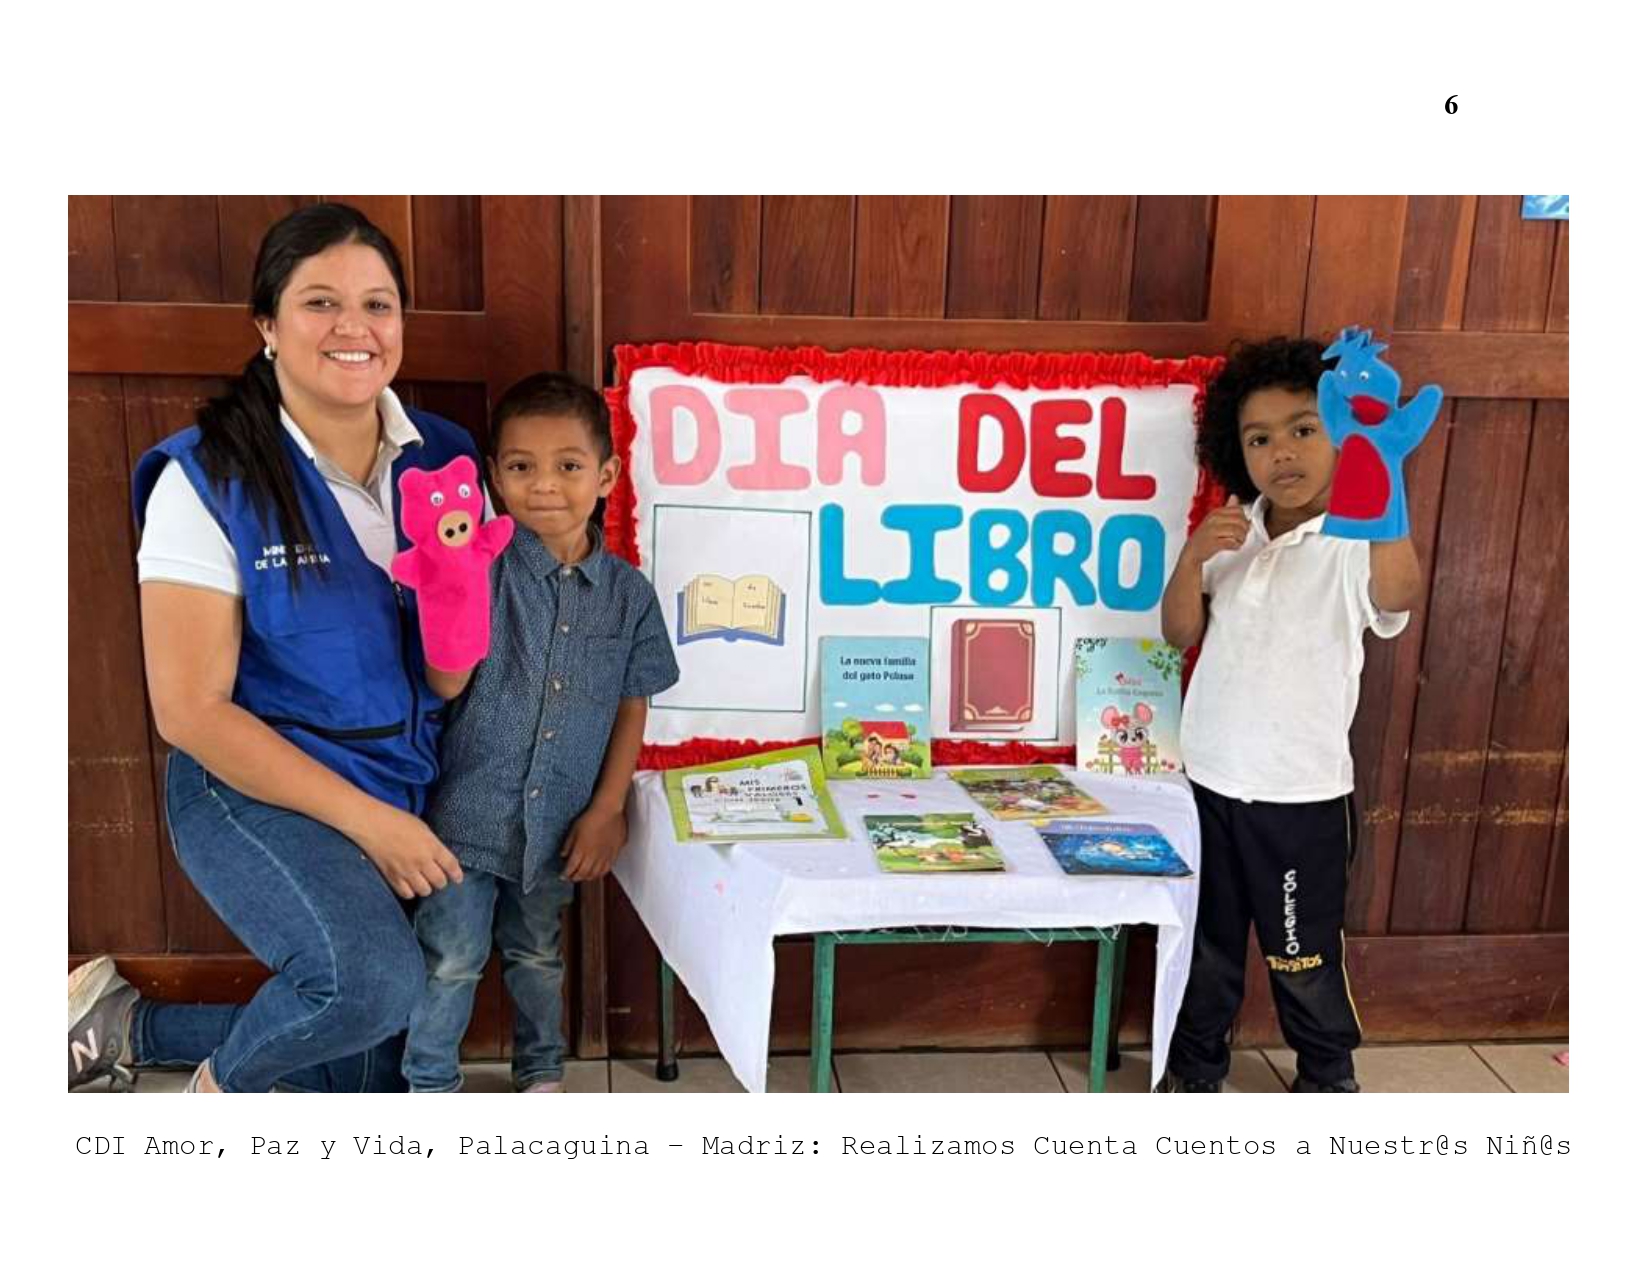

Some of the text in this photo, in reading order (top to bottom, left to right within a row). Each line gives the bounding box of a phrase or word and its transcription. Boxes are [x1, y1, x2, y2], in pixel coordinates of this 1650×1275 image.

[649, 384, 1157, 501] DIA DEL
[255, 559, 268, 570] DE
[272, 557, 287, 568] LA
[819, 503, 1166, 612] LIBRO
[840, 656, 851, 665] La
[884, 656, 916, 666] familia
[842, 671, 858, 680] del
[859, 672, 881, 681] gato
[739, 778, 760, 786] MIS
[747, 784, 807, 792] PRIMEROS
[1283, 869, 1300, 955] COLEGIO
[71, 1027, 99, 1073] N
